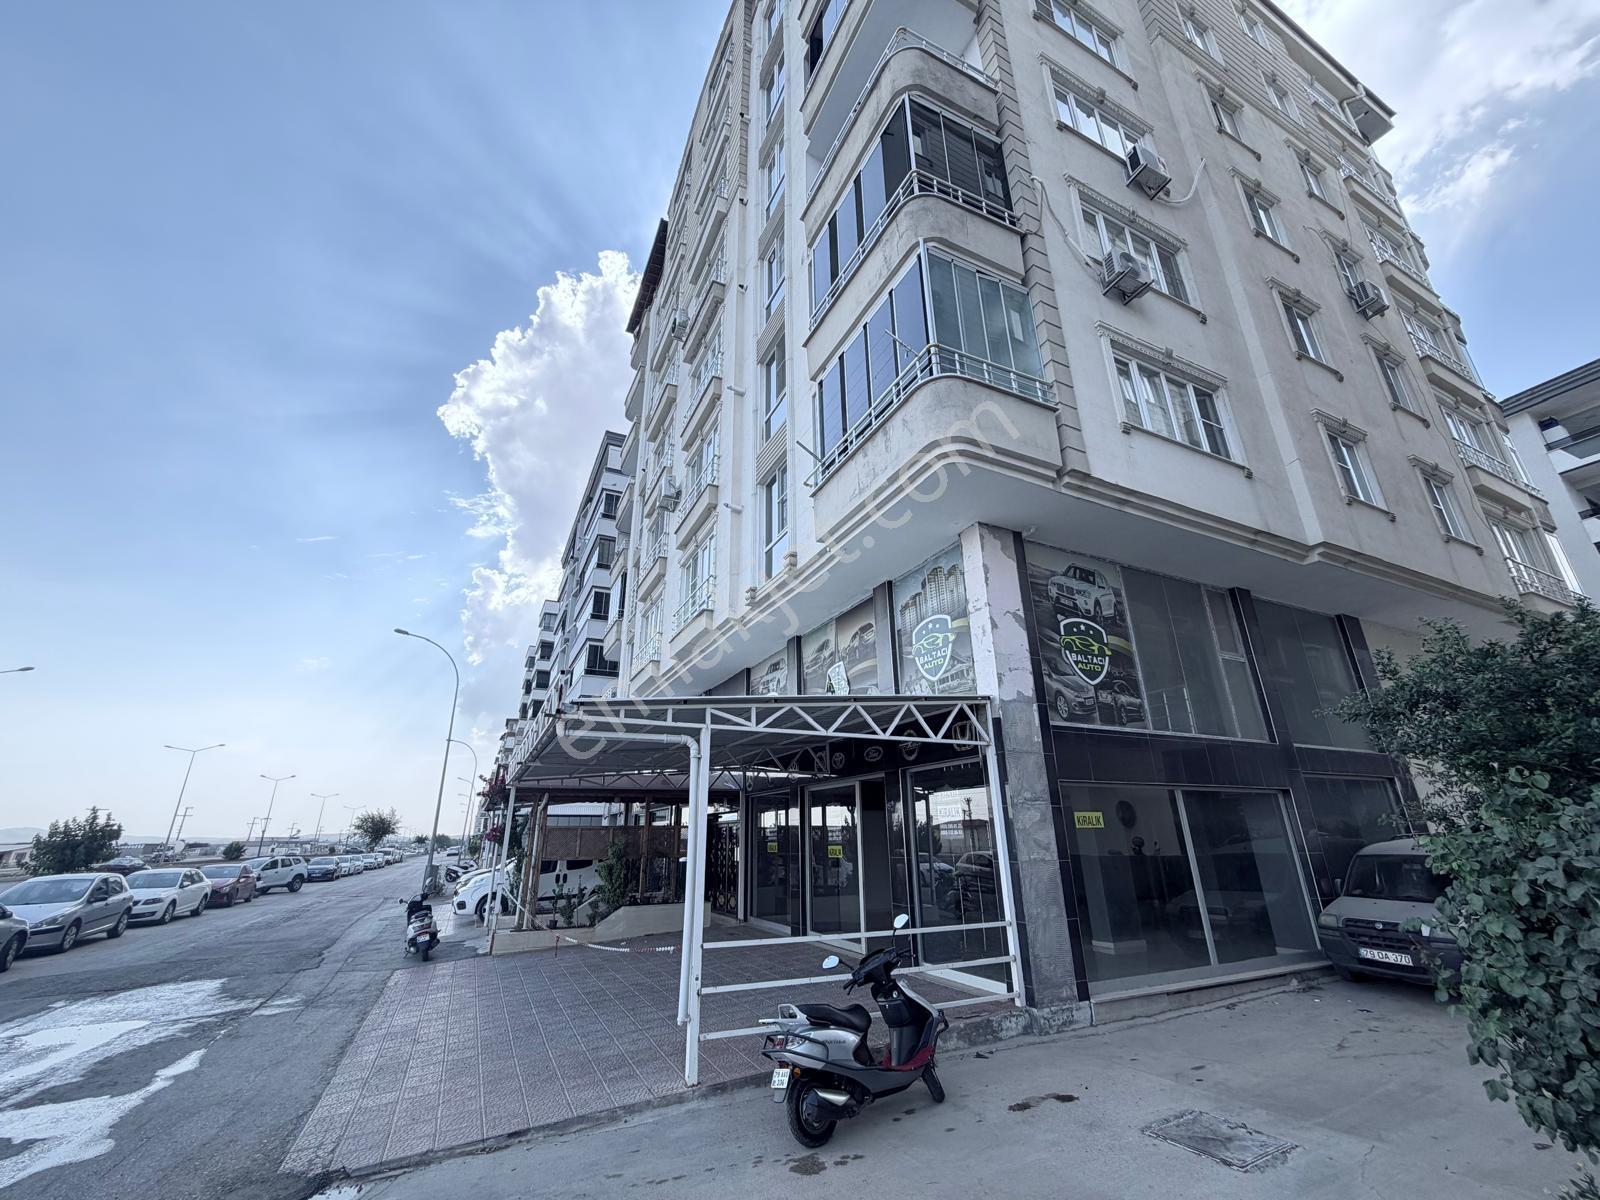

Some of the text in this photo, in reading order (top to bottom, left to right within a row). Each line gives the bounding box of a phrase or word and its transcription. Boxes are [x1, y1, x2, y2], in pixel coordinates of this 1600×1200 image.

[919, 647, 948, 664] BALTACI
[1071, 652, 1105, 665] BALTACI
[923, 657, 944, 670] AUTO
[1077, 662, 1102, 672] AUTO
[1363, 949, 1375, 958] 79
[1392, 954, 1411, 964] 370
